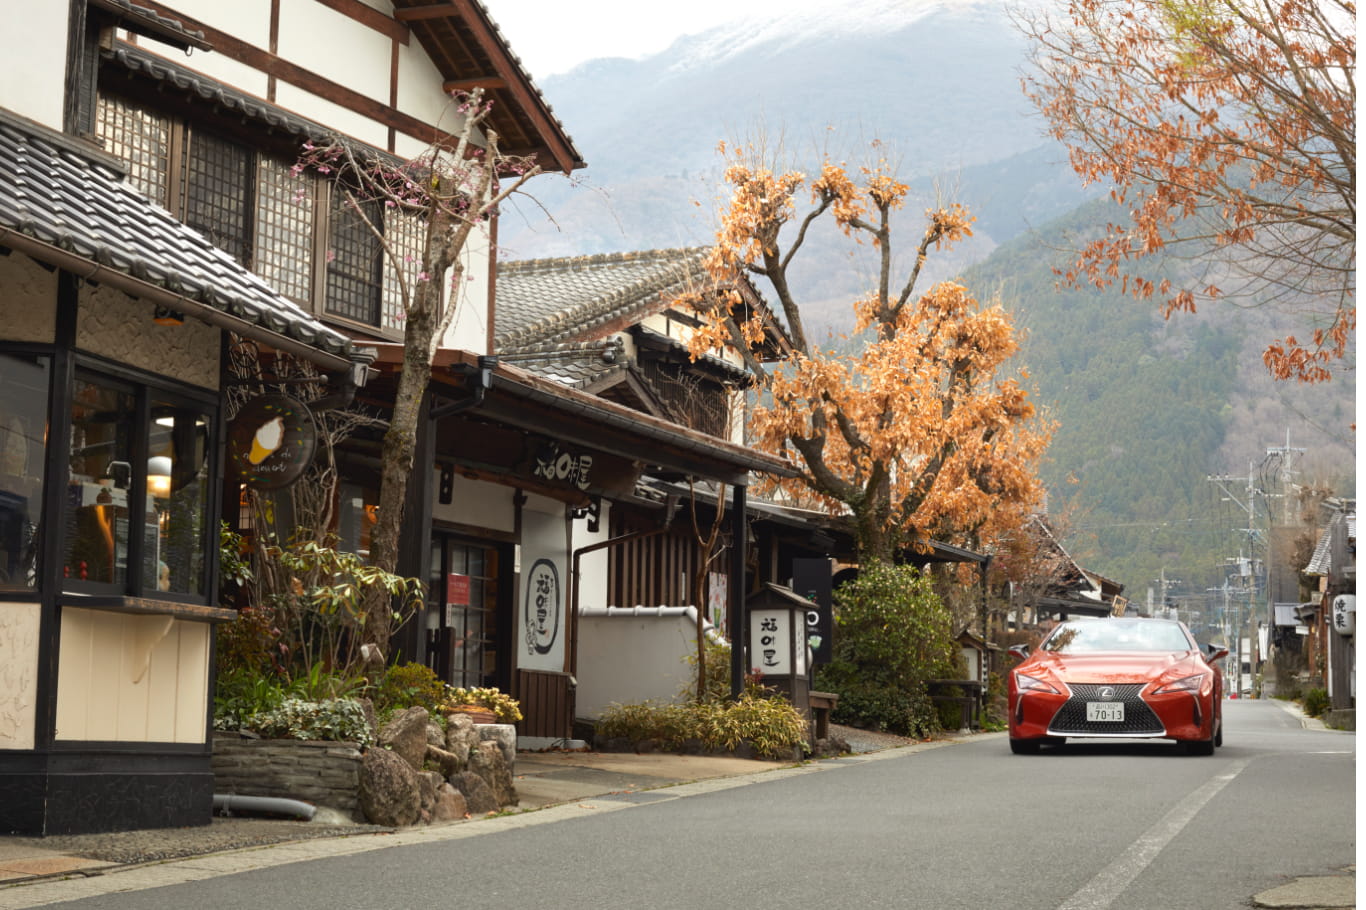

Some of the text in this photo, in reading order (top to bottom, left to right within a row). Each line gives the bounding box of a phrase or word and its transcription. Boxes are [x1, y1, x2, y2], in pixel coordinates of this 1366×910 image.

[760, 618, 780, 667] 福味屋
[1095, 710, 1122, 720] 70-13
